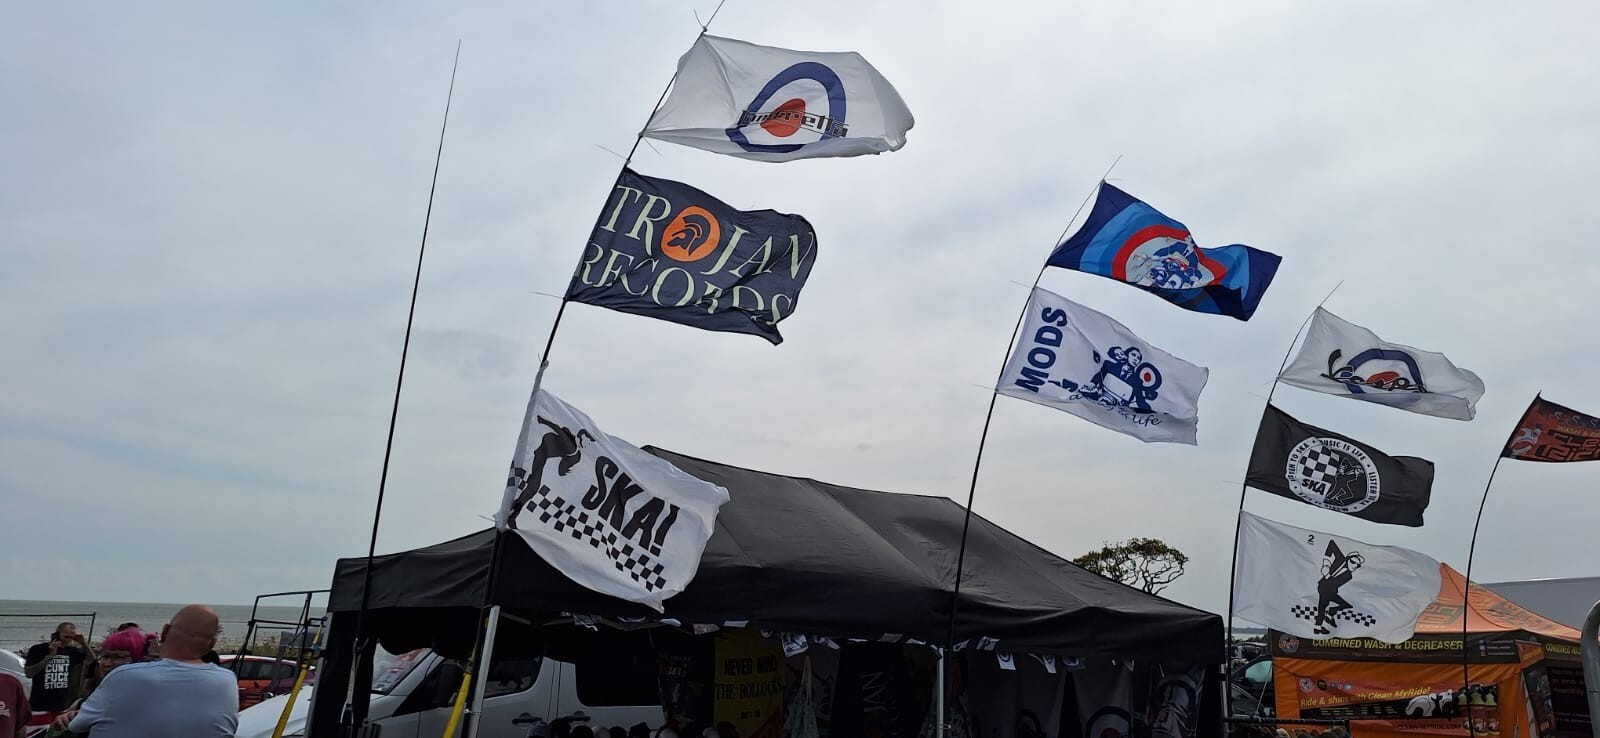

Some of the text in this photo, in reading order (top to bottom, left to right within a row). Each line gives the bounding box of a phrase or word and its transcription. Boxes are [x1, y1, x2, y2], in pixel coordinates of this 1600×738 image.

[581, 242, 794, 326] RECORDS
[1014, 306, 1068, 393] MODS
[1301, 478, 1327, 497] SKA
[1312, 638, 1362, 649] COMBINED
[1363, 639, 1391, 650] WASH
[1404, 639, 1463, 650] DEGREASER
[45, 663, 70, 673] CUNT
[724, 656, 753, 676] NEVER
[44, 672, 69, 682] FUCK
[1300, 698, 1317, 708] Ride
[1367, 690, 1392, 700] Clean
